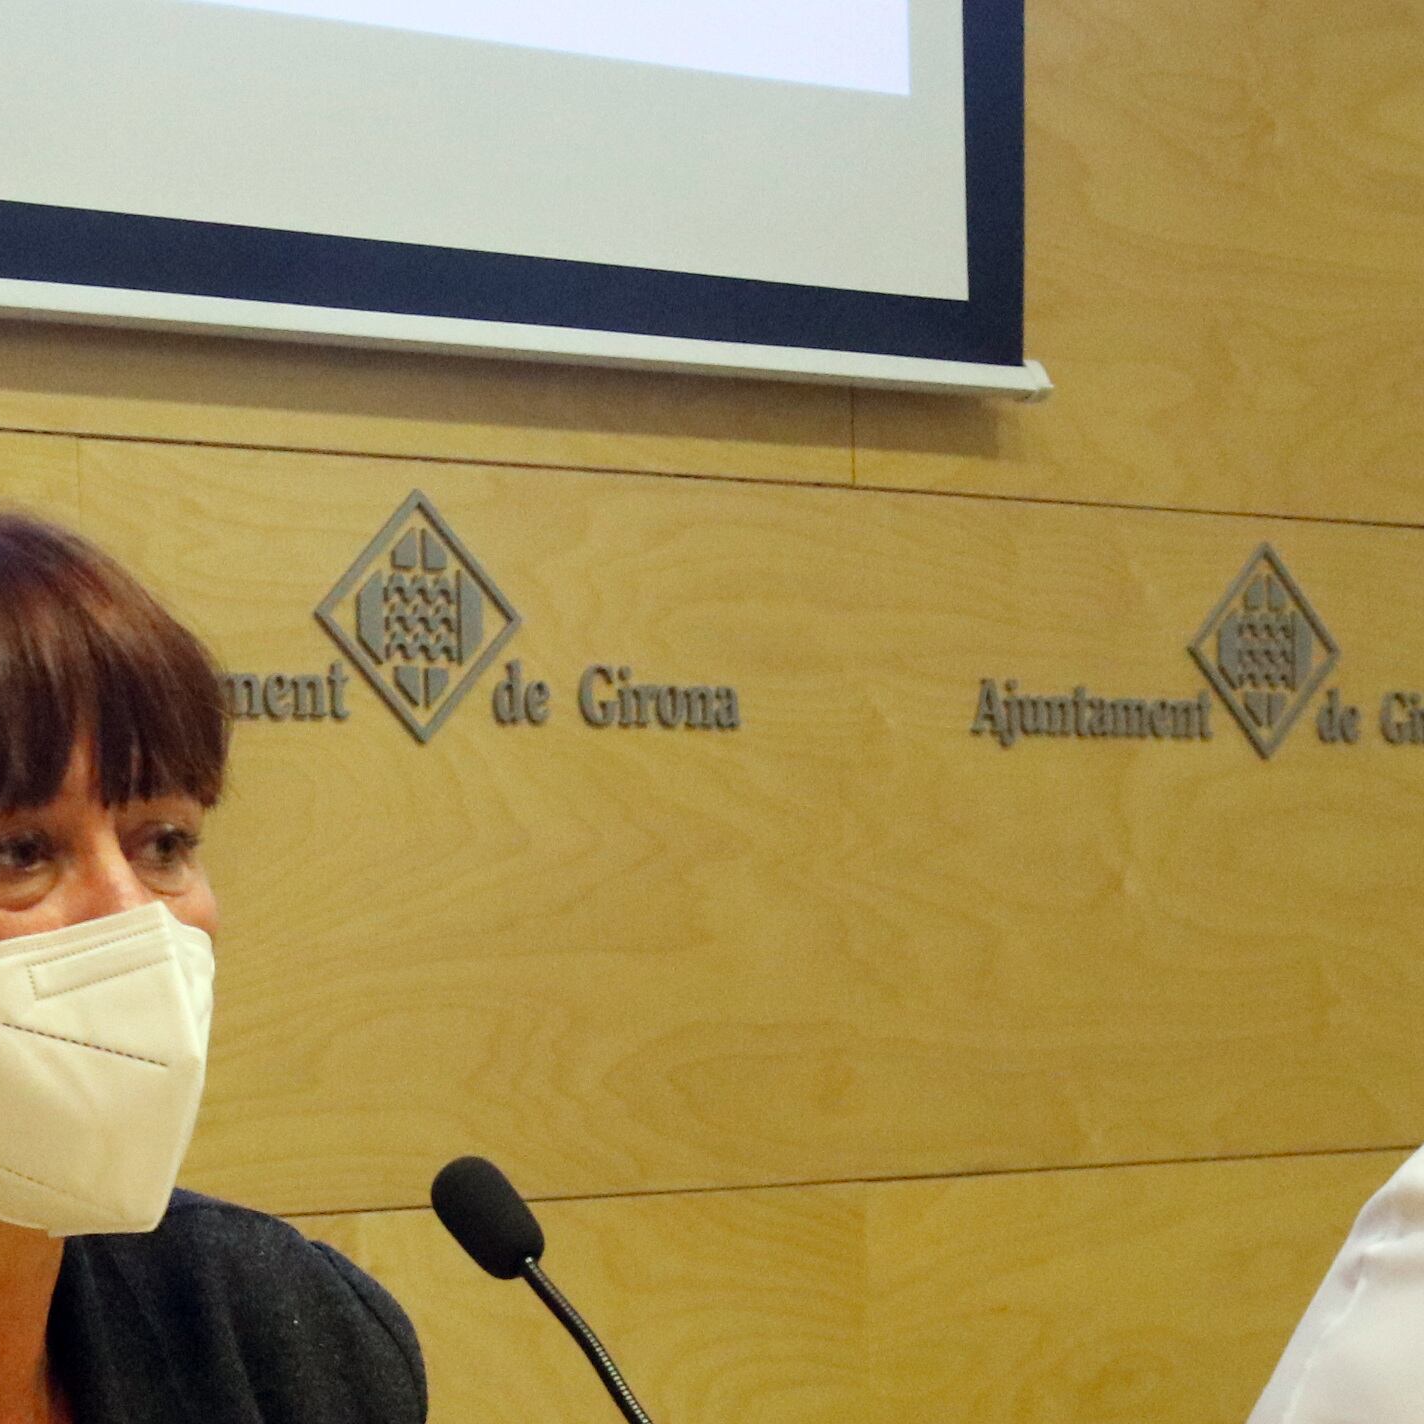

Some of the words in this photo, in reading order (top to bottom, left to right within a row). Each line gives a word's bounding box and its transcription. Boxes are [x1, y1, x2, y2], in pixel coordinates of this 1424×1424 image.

[492, 659, 551, 726] de
[578, 663, 740, 730] Girona
[970, 678, 1213, 748] Ajuntament
[1316, 687, 1361, 744] de
